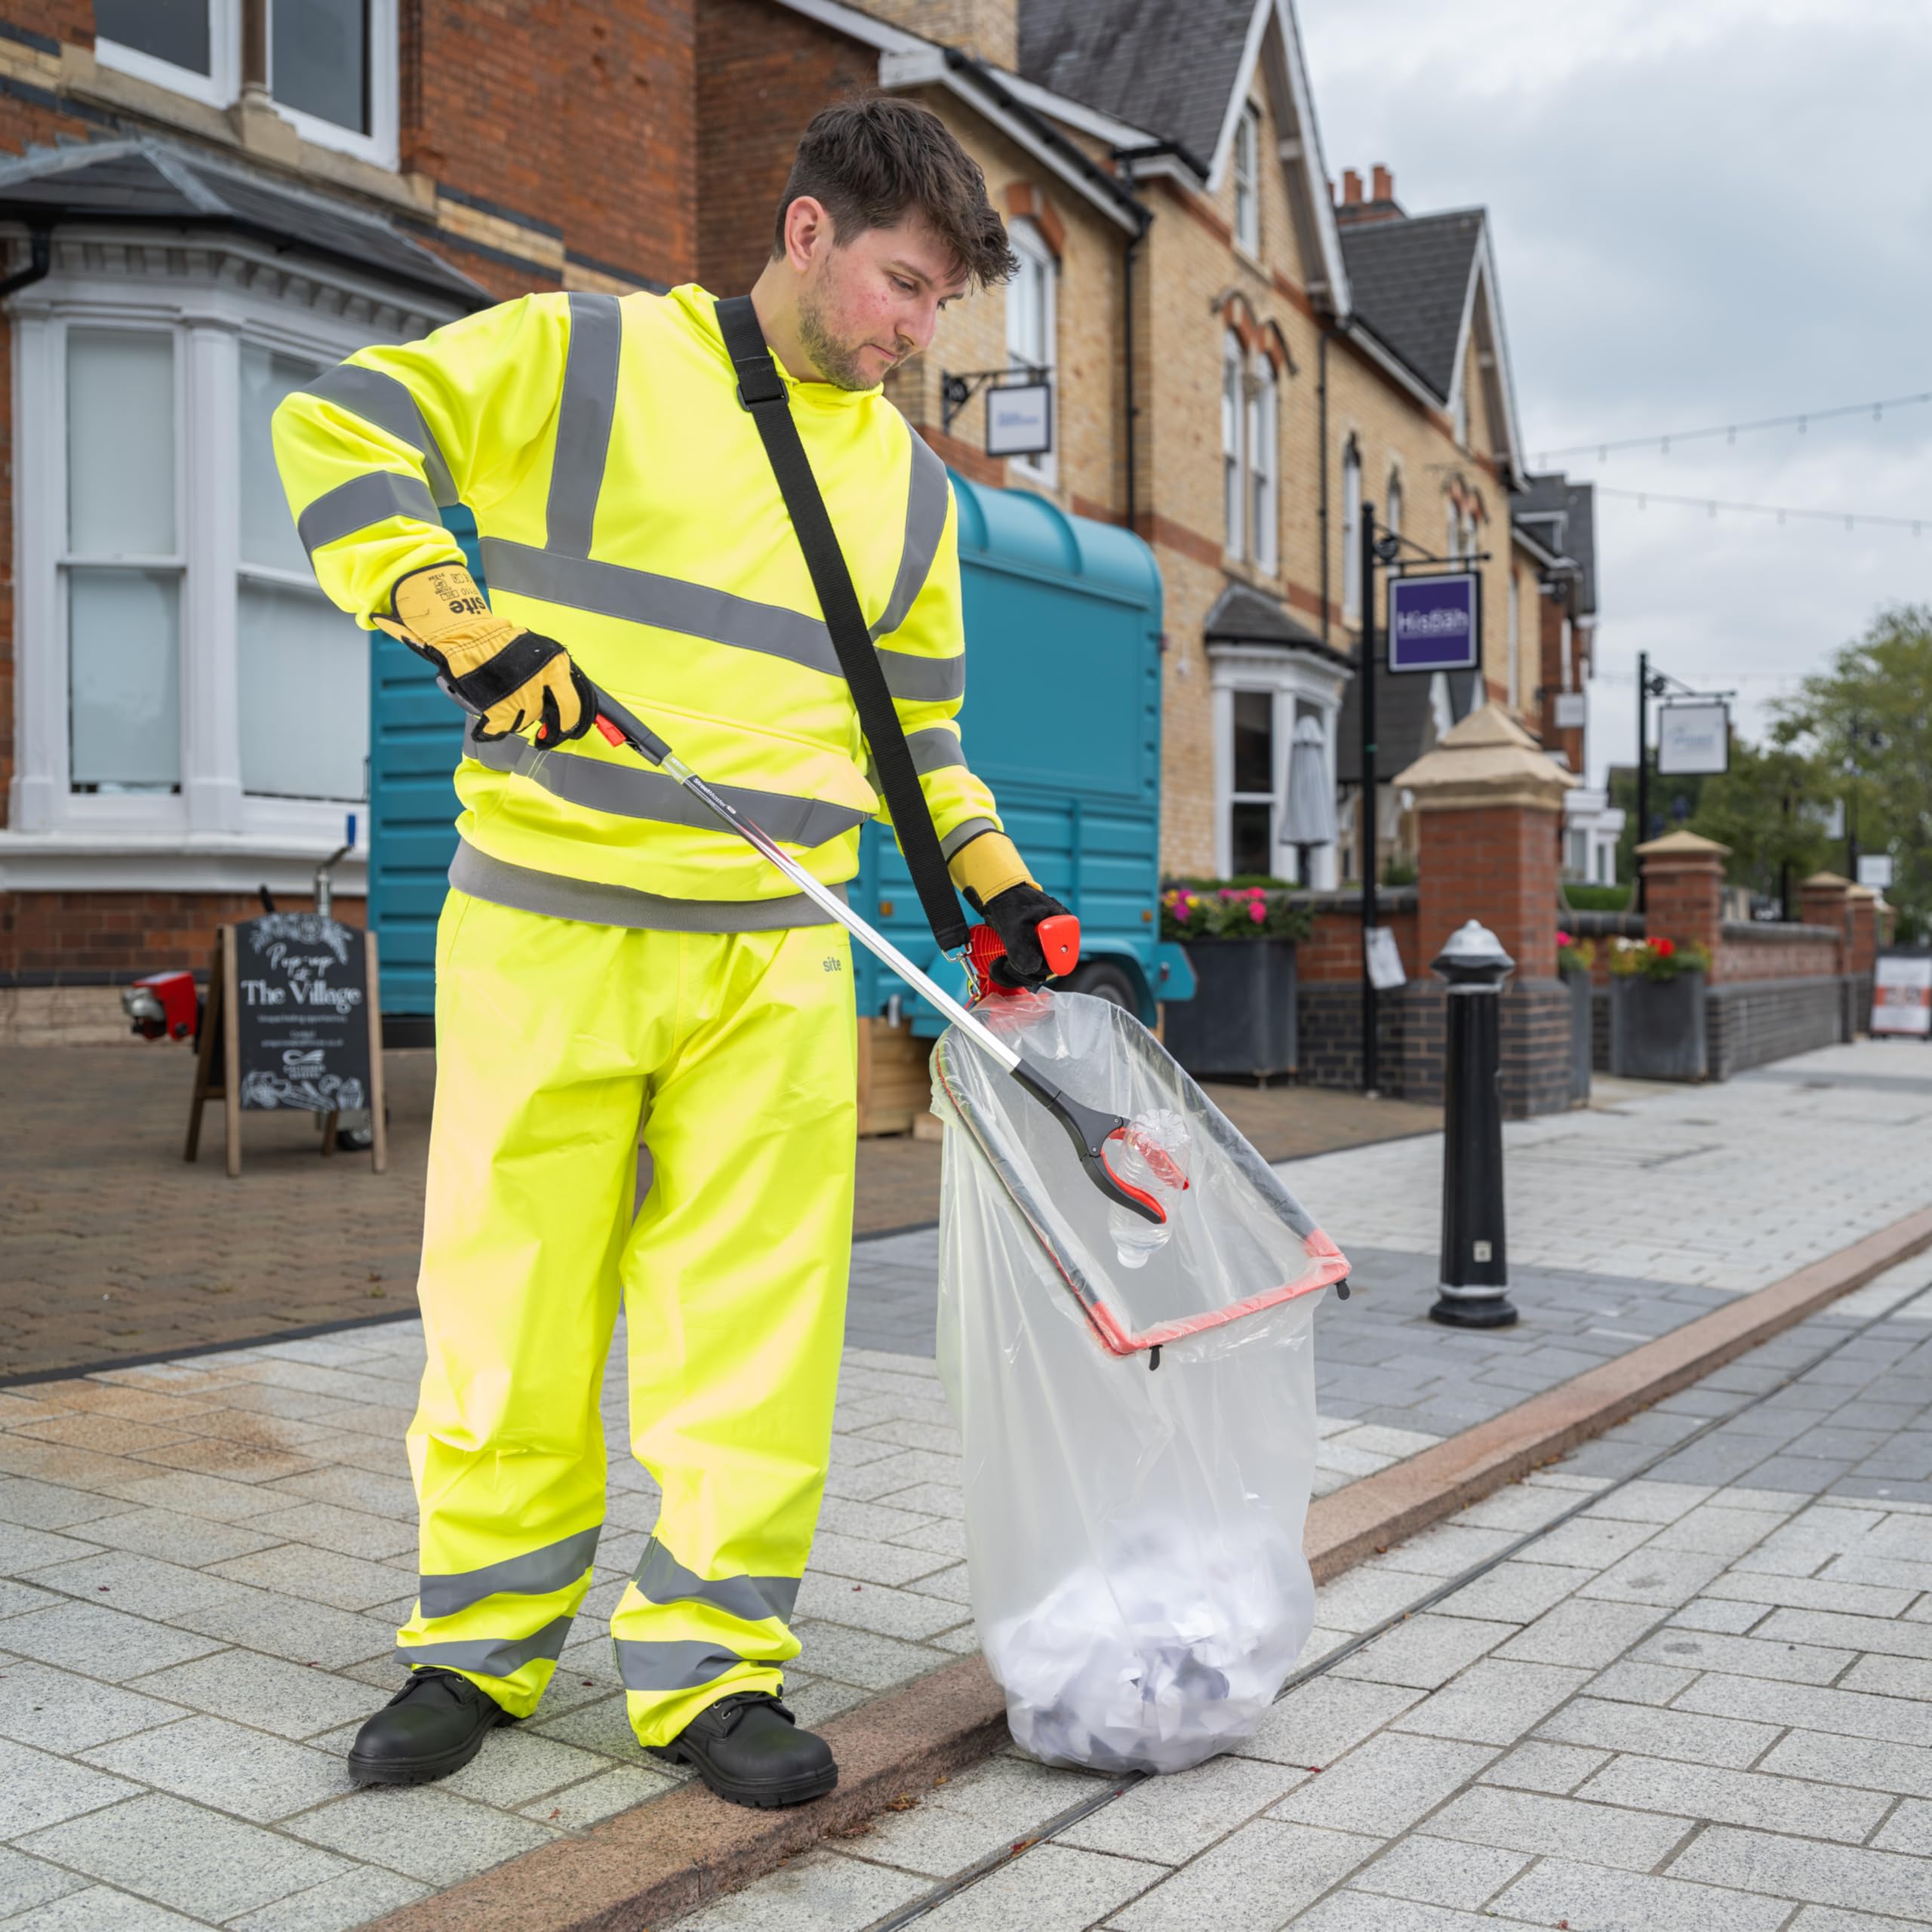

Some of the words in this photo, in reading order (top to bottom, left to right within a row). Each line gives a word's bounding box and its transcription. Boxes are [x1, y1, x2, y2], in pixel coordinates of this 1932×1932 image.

[449, 597, 486, 614] site
[693, 778, 727, 807] StreetMaster
[266, 942, 336, 977] Pop-up
[823, 956, 841, 972] site
[241, 980, 286, 1005] The
[288, 980, 361, 1014] Village
